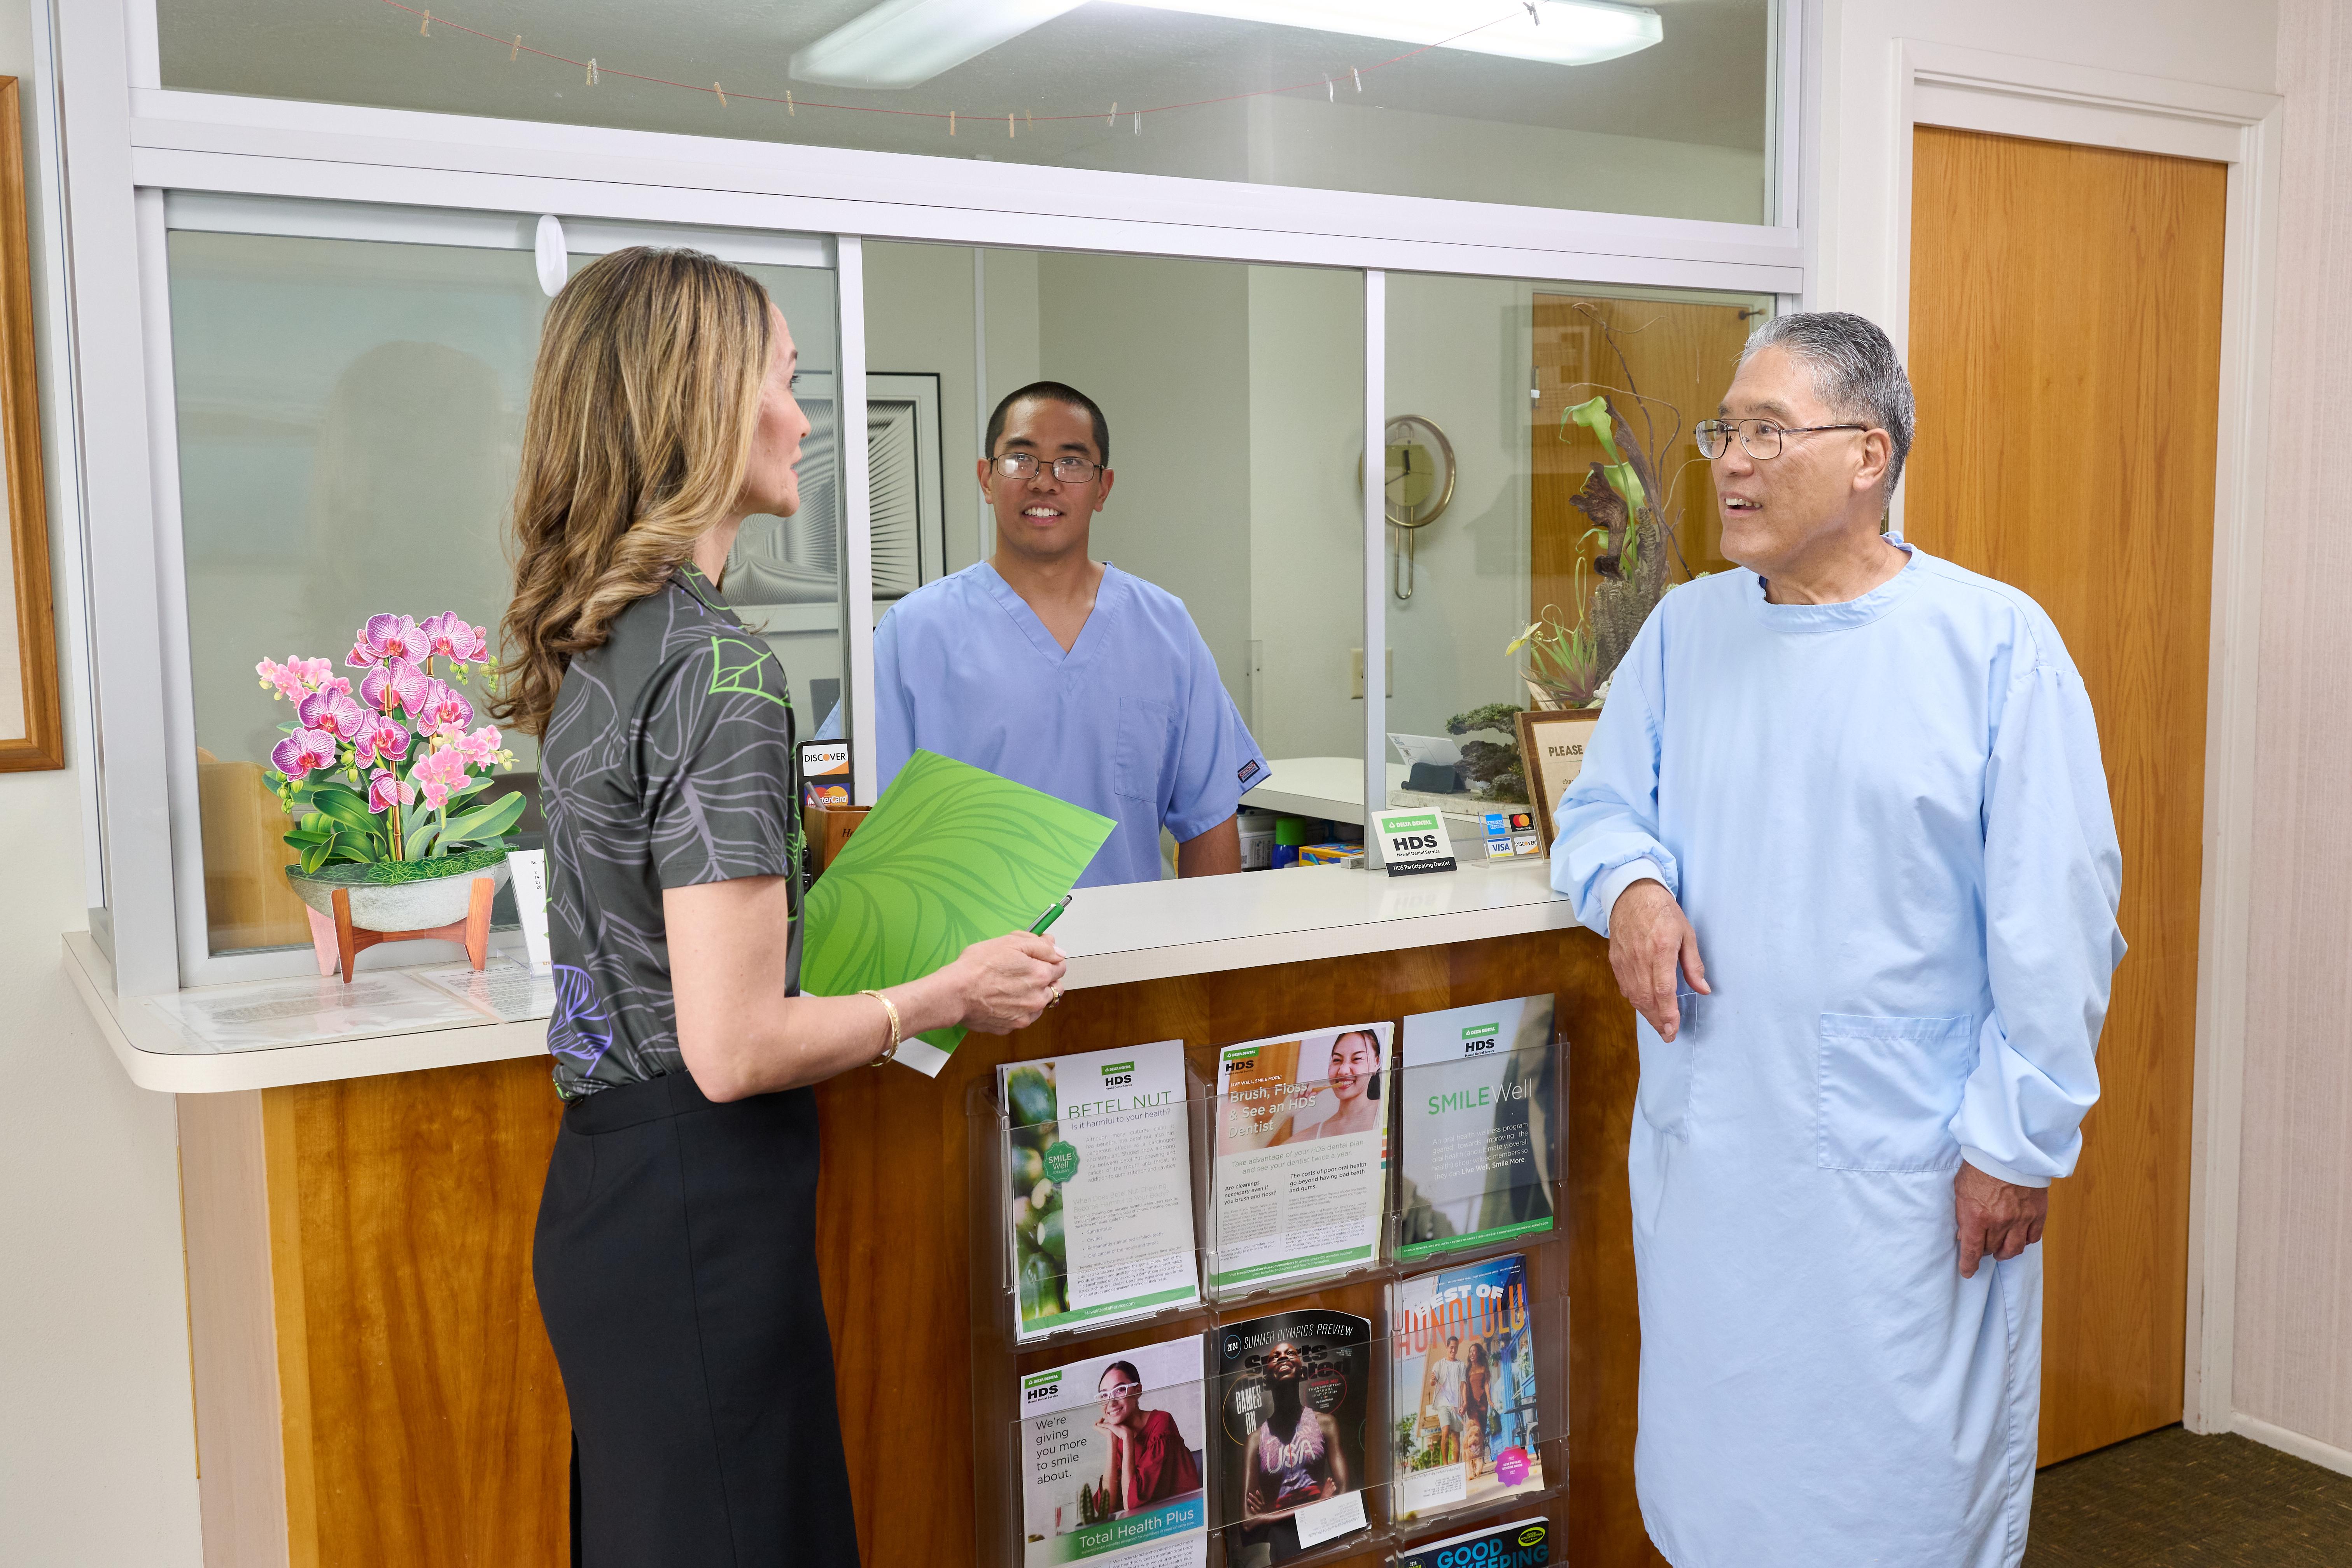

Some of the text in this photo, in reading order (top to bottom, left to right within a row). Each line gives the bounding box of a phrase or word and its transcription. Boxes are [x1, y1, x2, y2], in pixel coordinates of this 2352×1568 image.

[804, 752, 846, 762] DISCOVER
[1549, 745, 1583, 757] PLEASE
[808, 795, 847, 805] MterCard
[1393, 835, 1437, 850] HDS
[1491, 843, 1510, 851] VISA
[1465, 1039, 1494, 1052] HDS
[1225, 1060, 1254, 1072] HDS
[1105, 1075, 1132, 1086] HDS
[1230, 1083, 1307, 1103] Brush, Floss
[1069, 1091, 1171, 1119] BETEL NUT
[1229, 1095, 1316, 1121] & See an HDS
[1087, 1117, 1114, 1127] harmful
[1145, 1108, 1170, 1117] health?
[1229, 1120, 1274, 1138] Dentist
[1477, 1127, 1500, 1136] wellness
[1503, 1122, 1528, 1132] program
[1433, 1145, 1453, 1154] geared
[1458, 1140, 1481, 1148] towards
[1486, 1134, 1514, 1143] improving
[1479, 1144, 1508, 1154] ultimately,
[1509, 1139, 1528, 1148] overall
[1049, 1153, 1072, 1164] SMILE
[1053, 1161, 1068, 1170] Well
[1249, 1154, 1283, 1164] advantage
[1433, 1162, 1453, 1171] health)
[1493, 1150, 1520, 1158] members
[1476, 1284, 1504, 1299] OF
[1227, 1324, 1353, 1352] 2024 SUMMER OLYMPICS PREVIEW
[1028, 1385, 1058, 1400] HDS
[1236, 1385, 1262, 1414] GAMES
[1036, 1416, 1066, 1430] We're
[1245, 1412, 1256, 1435] ON
[1036, 1428, 1069, 1445] giving
[1036, 1438, 1087, 1459] you more
[1037, 1454, 1079, 1471] to smile
[1267, 1440, 1316, 1474] USA
[1037, 1469, 1071, 1485] about.
[1079, 1509, 1194, 1549] Total Health Plus
[1437, 1538, 1503, 1568] GOOD
